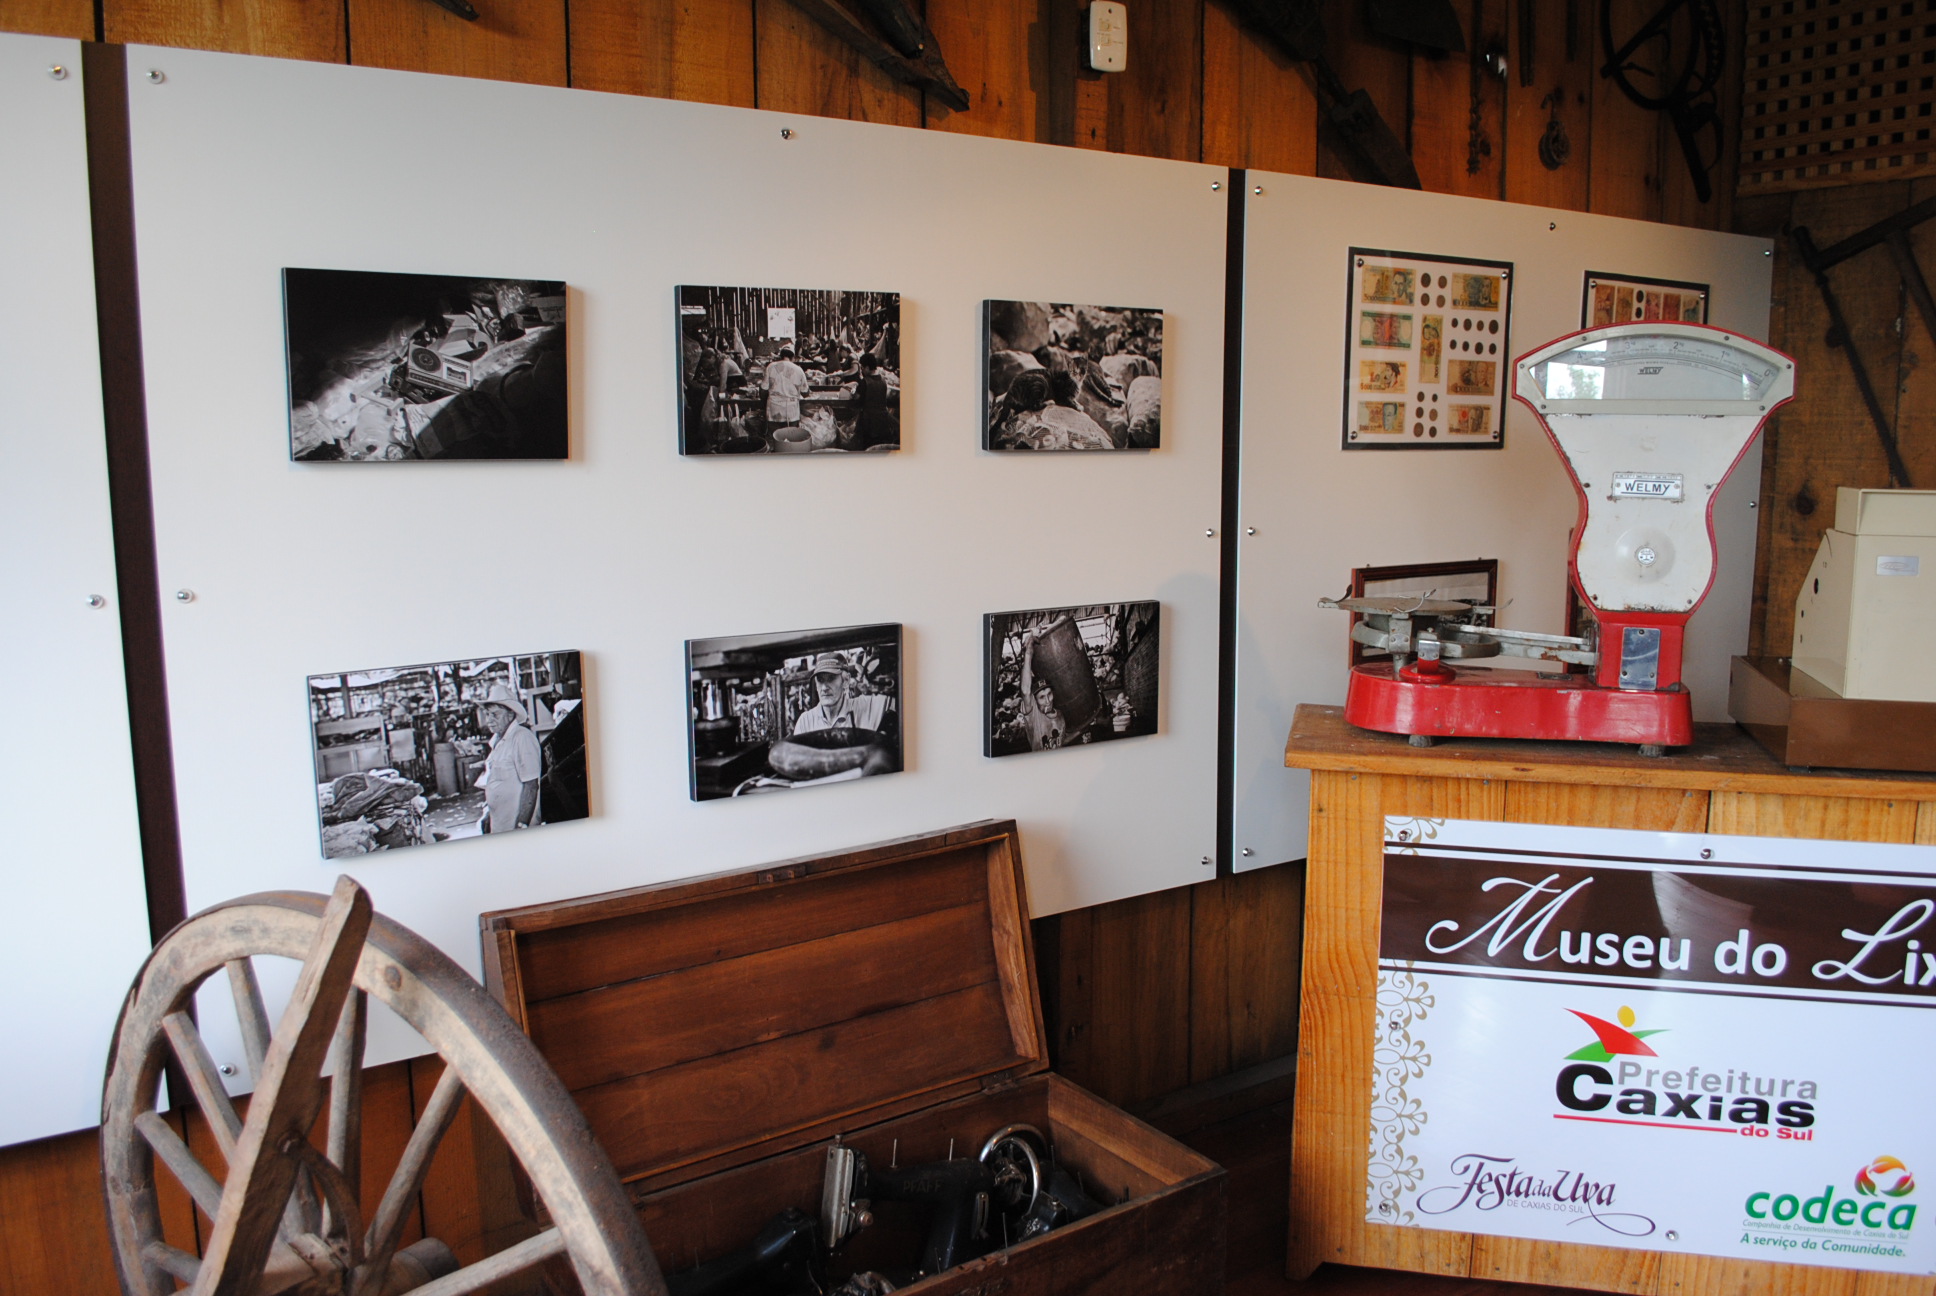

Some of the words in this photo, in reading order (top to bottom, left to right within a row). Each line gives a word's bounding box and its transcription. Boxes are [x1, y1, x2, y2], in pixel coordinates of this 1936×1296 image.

[1638, 367, 1663, 375] WELMY
[1624, 481, 1671, 495] WELMY
[1425, 873, 1690, 971] Museu
[1713, 929, 1787, 977] do
[1618, 1061, 1818, 1100] Prefeitura
[1555, 1063, 1815, 1128] Caxias
[1740, 1125, 1769, 1137] do
[1776, 1127, 1813, 1141] Sul
[1416, 1154, 1534, 1214] Festa
[1506, 1199, 1519, 1207] DE
[1520, 1200, 1551, 1210] CAXIAS
[1553, 1203, 1567, 1212] DO
[1568, 1204, 1585, 1214] SUL
[1744, 1184, 1917, 1231] codeca
[1742, 1219, 1781, 1228] Companhia
[1740, 1232, 1749, 1243] A
[1753, 1235, 1798, 1251] serviço
[1801, 1238, 1818, 1249] da
[1821, 1239, 1906, 1257] Comunidade.
